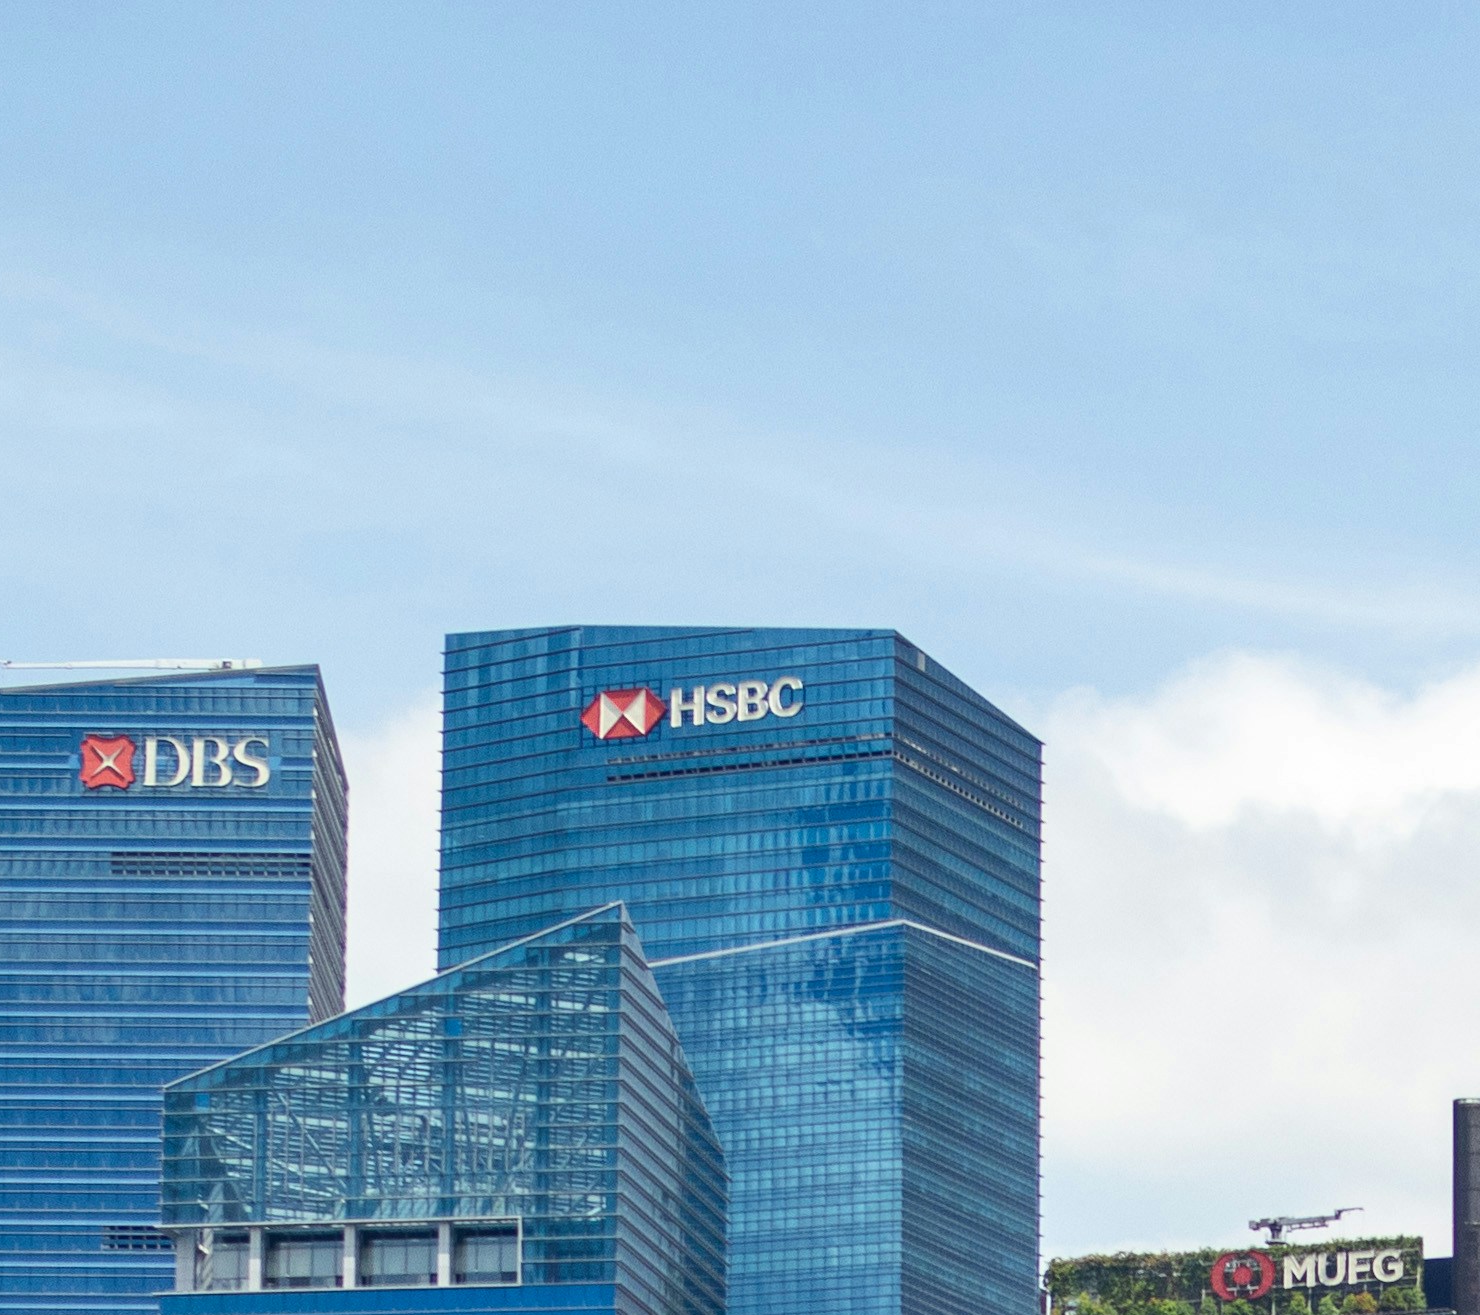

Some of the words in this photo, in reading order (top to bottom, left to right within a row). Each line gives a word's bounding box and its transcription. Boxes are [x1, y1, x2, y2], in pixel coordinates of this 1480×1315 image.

[670, 676, 804, 728] HSBC
[143, 736, 270, 787] DBS
[1283, 1248, 1404, 1290] MUFG
